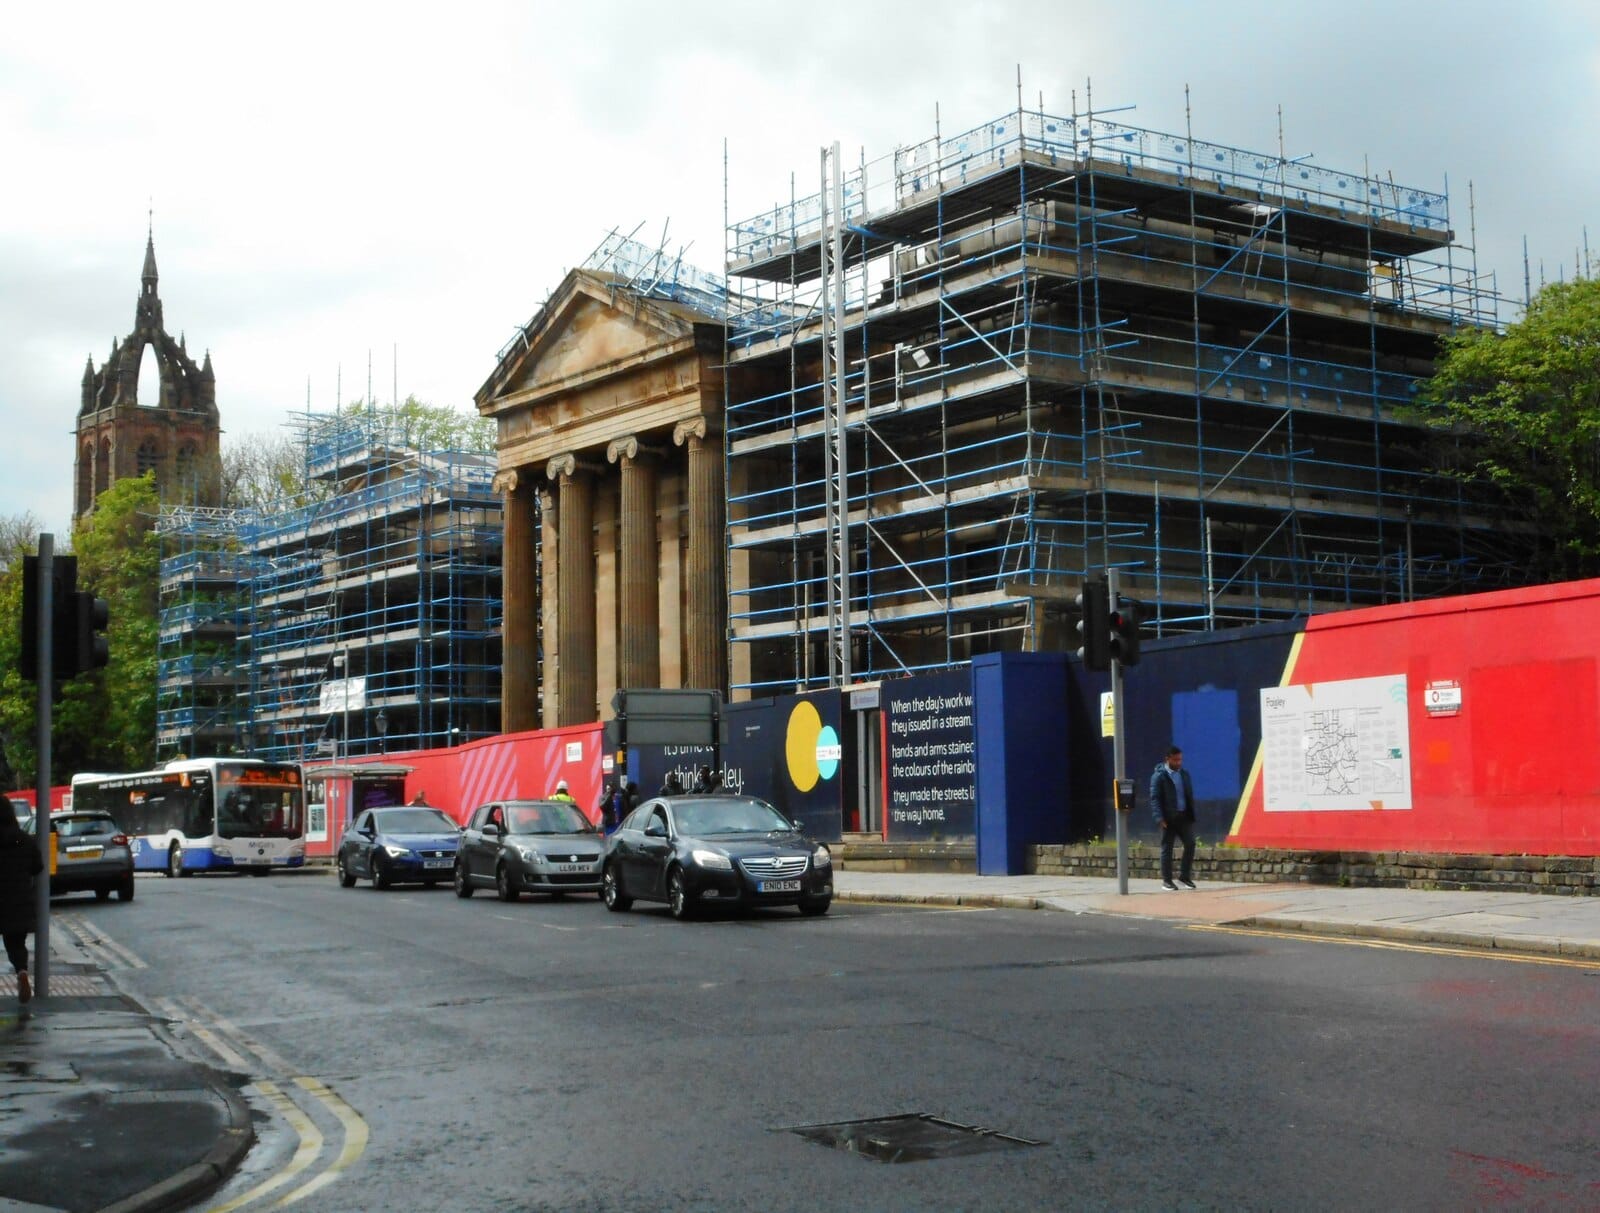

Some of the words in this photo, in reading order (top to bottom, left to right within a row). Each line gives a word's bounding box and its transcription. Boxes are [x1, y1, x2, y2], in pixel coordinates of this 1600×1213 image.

[891, 699, 911, 714] When
[912, 697, 924, 712] the
[925, 696, 944, 714] day's
[945, 692, 963, 709] work
[964, 695, 974, 707] w
[891, 719, 907, 737] they
[908, 715, 931, 732] issued
[932, 716, 939, 729] in
[939, 717, 945, 729] a
[892, 743, 913, 758] hands
[914, 741, 928, 757] and
[929, 743, 947, 756] arms
[892, 762, 904, 777] the
[904, 762, 931, 777] colours
[932, 760, 940, 776] of
[941, 760, 953, 775] the
[893, 789, 909, 806] they
[910, 786, 930, 801] made
[931, 786, 943, 801] the
[944, 787, 968, 801] streets
[894, 808, 906, 822] the
[907, 809, 921, 825] way
